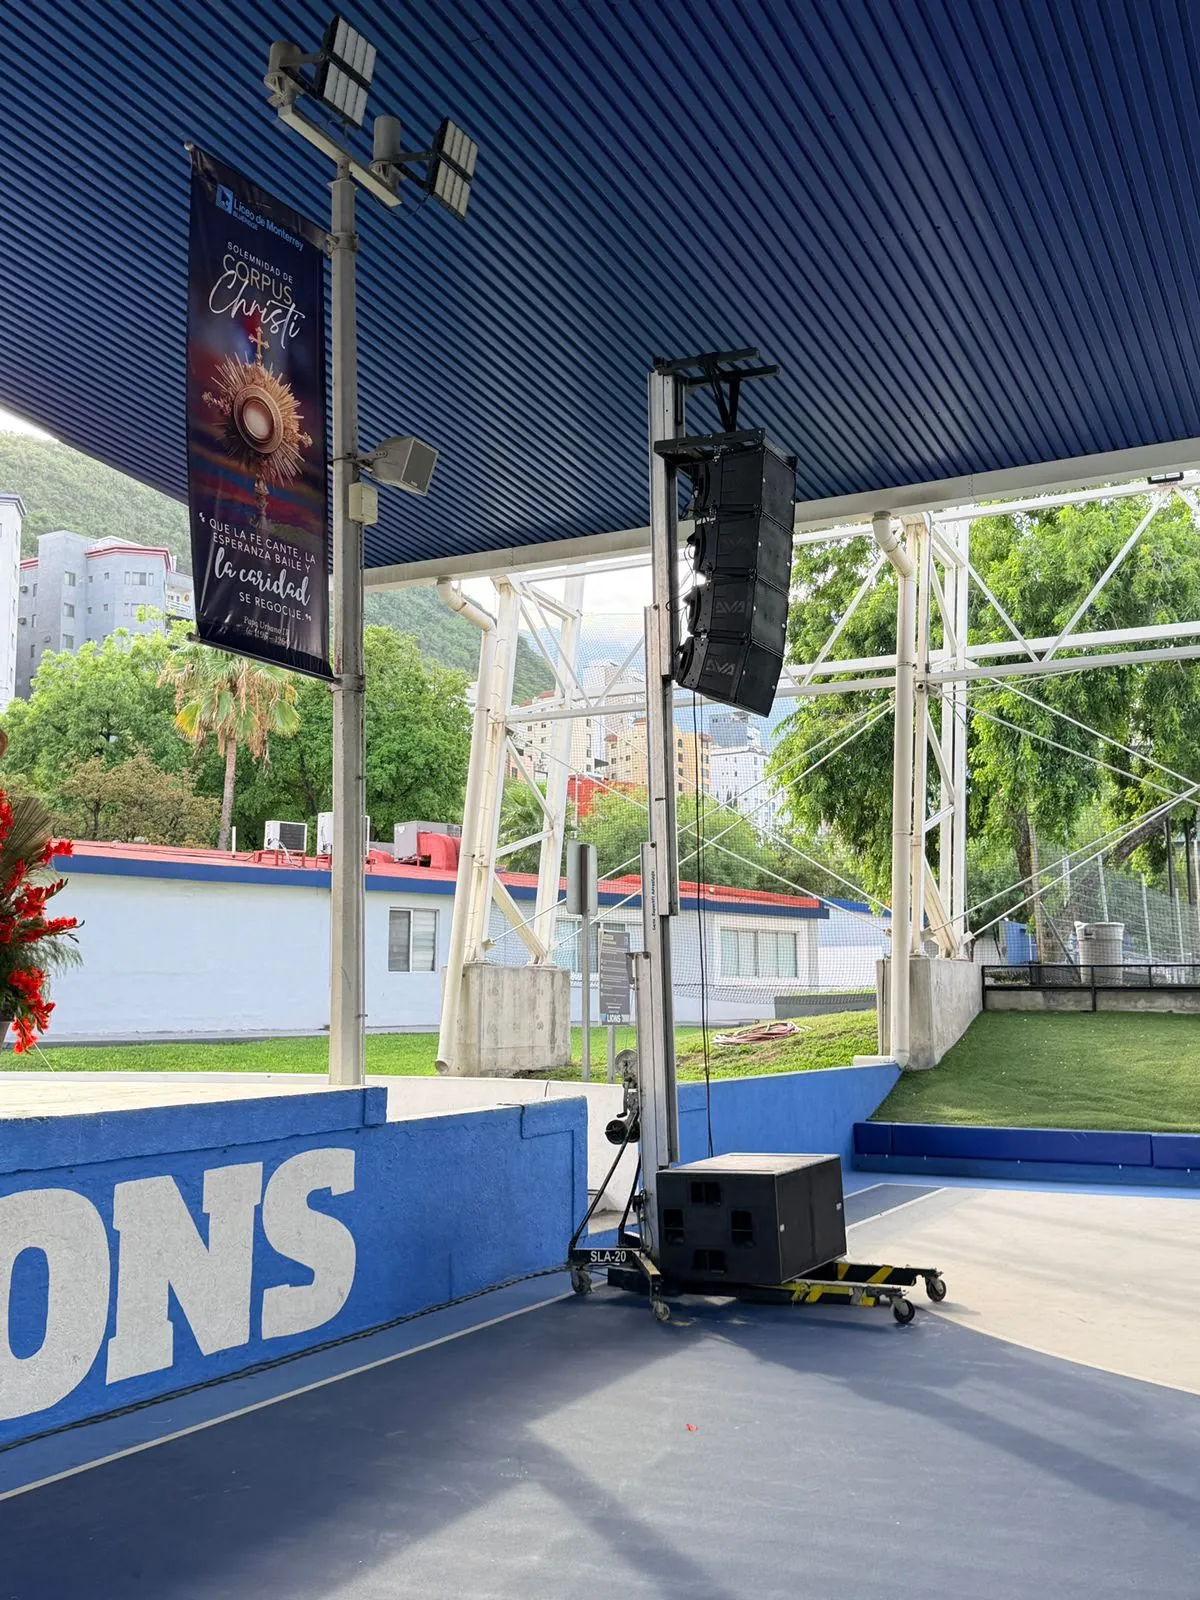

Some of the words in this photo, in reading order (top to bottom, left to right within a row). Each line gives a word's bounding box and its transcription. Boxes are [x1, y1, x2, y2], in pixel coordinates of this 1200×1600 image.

[234, 199, 255, 222] Liceo
[255, 214, 265, 227] de
[266, 218, 304, 252] Monterrey
[222, 254, 293, 304] CORPUS
[227, 241, 281, 277] SOLEMNIDAD
[283, 272, 293, 284] DE
[208, 270, 306, 350] Christi
[213, 532, 271, 561] ESPERANZA
[275, 553, 302, 571] BAILE
[305, 564, 311, 574] Y
[234, 527, 246, 540] LA
[250, 533, 261, 545] FE
[266, 538, 302, 560] CANTE,
[305, 552, 316, 564] LA
[214, 547, 237, 579] la
[239, 568, 311, 606] caridad
[239, 591, 251, 604] SE
[0, 1148, 356, 1421] ONS
